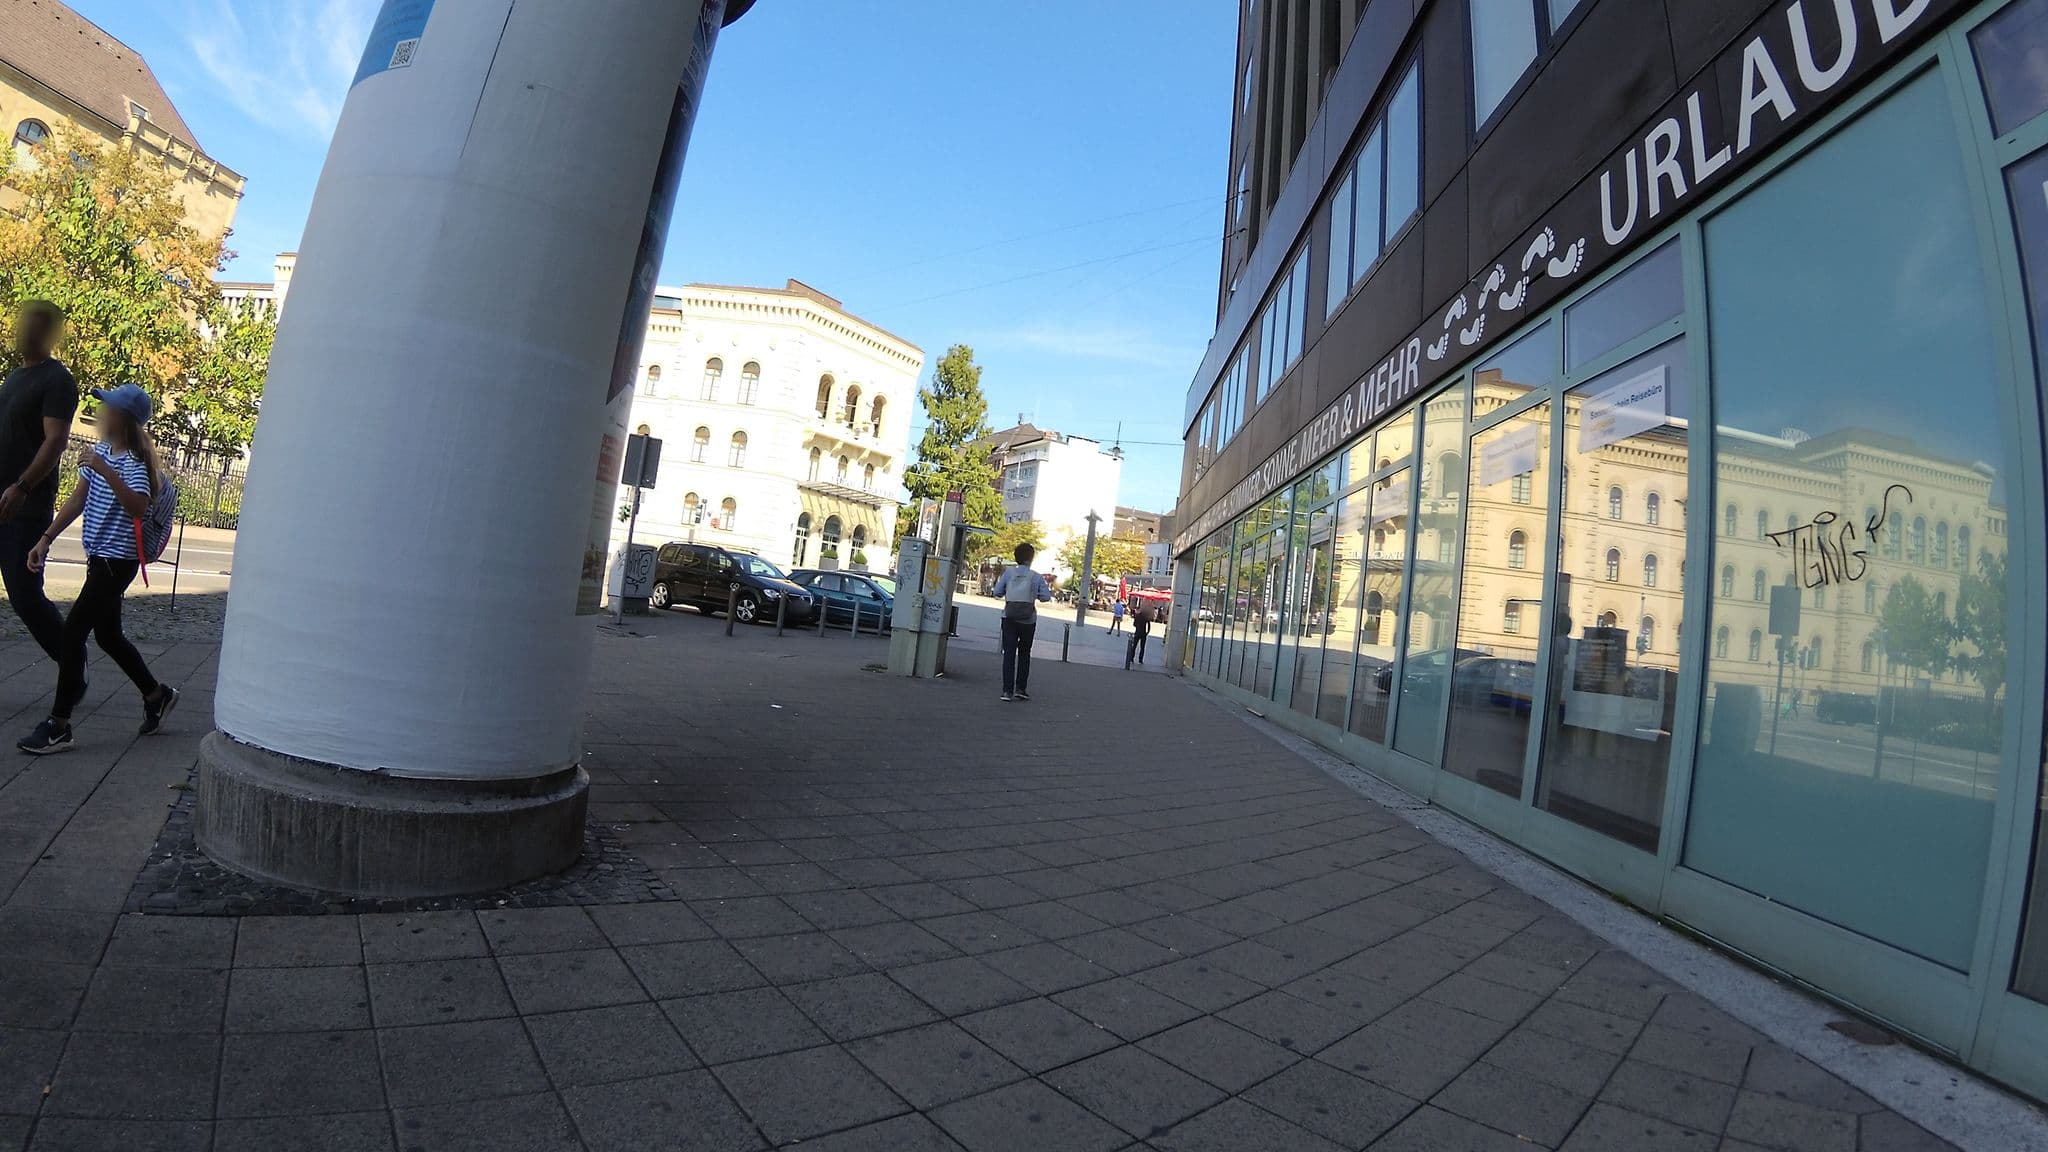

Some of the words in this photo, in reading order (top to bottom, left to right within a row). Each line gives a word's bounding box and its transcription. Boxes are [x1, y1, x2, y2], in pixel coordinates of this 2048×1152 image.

[1300, 405, 1339, 469] MEER
[1340, 393, 1354, 439] &
[1356, 337, 1421, 429] MEHR
[1630, 383, 1664, 404] Reisebüro
